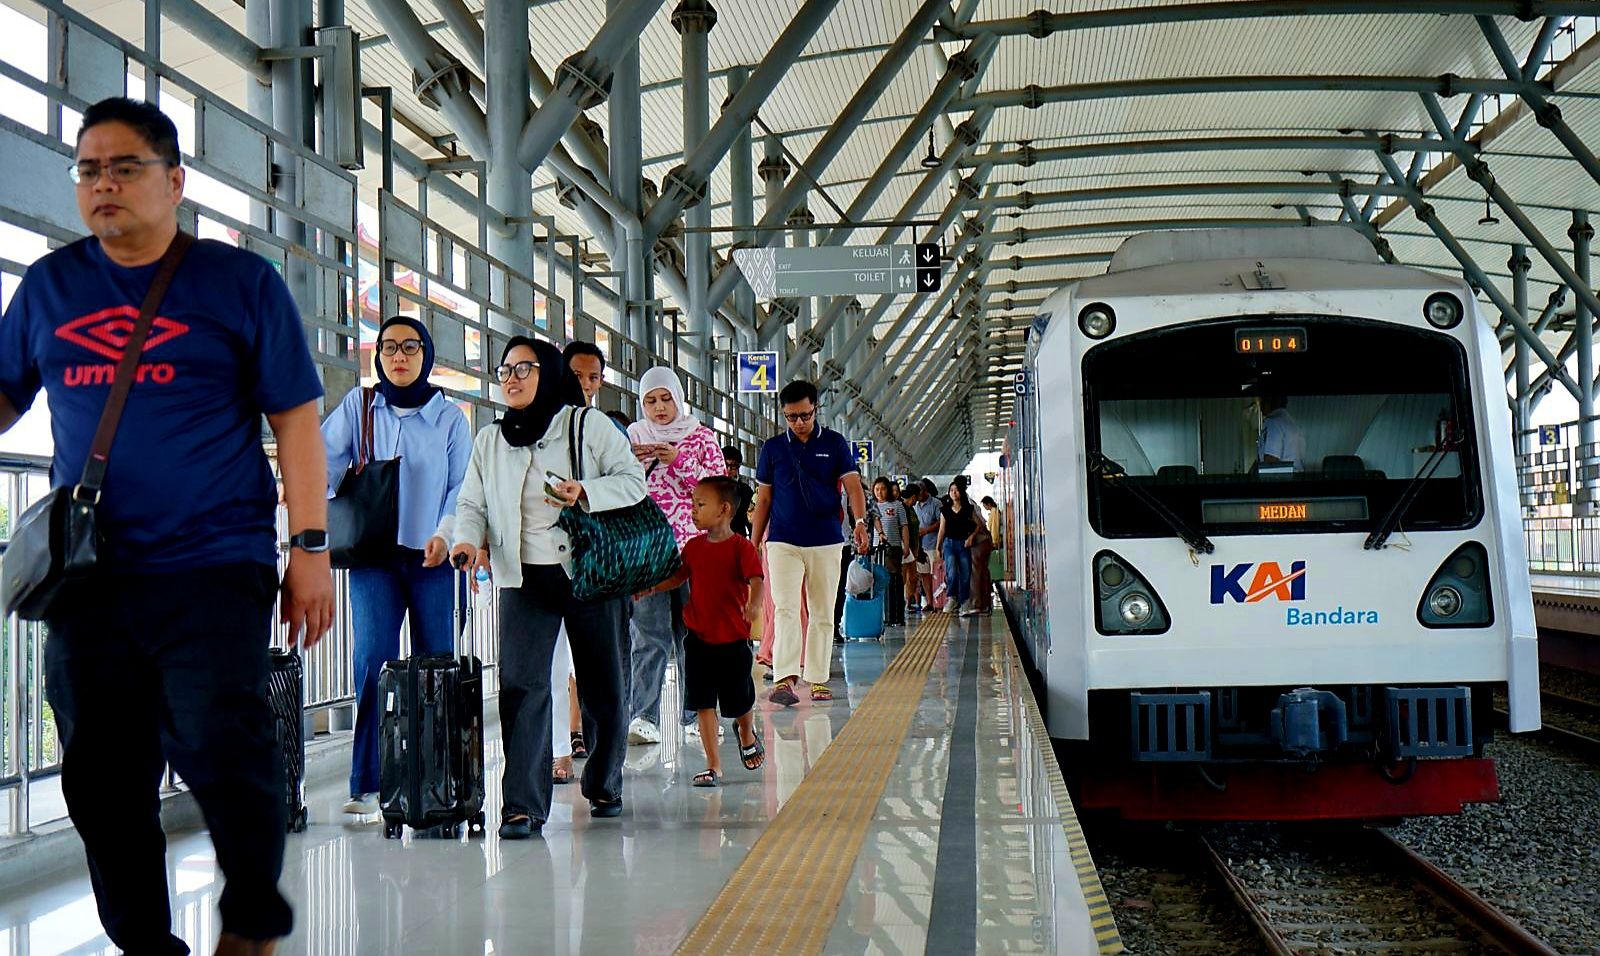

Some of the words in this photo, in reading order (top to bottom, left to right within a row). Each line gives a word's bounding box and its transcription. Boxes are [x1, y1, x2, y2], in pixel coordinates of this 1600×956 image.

[852, 248, 889, 258] KELUAR
[854, 272, 886, 282] TOILET
[1241, 337, 1297, 351] 0104
[64, 363, 175, 386] umro
[750, 364, 770, 392] 4
[1545, 430, 1556, 445] 3
[858, 447, 869, 463] 3
[1259, 504, 1307, 520] MEDAN
[1210, 560, 1306, 604] KAI
[1286, 606, 1379, 626] Bandara
